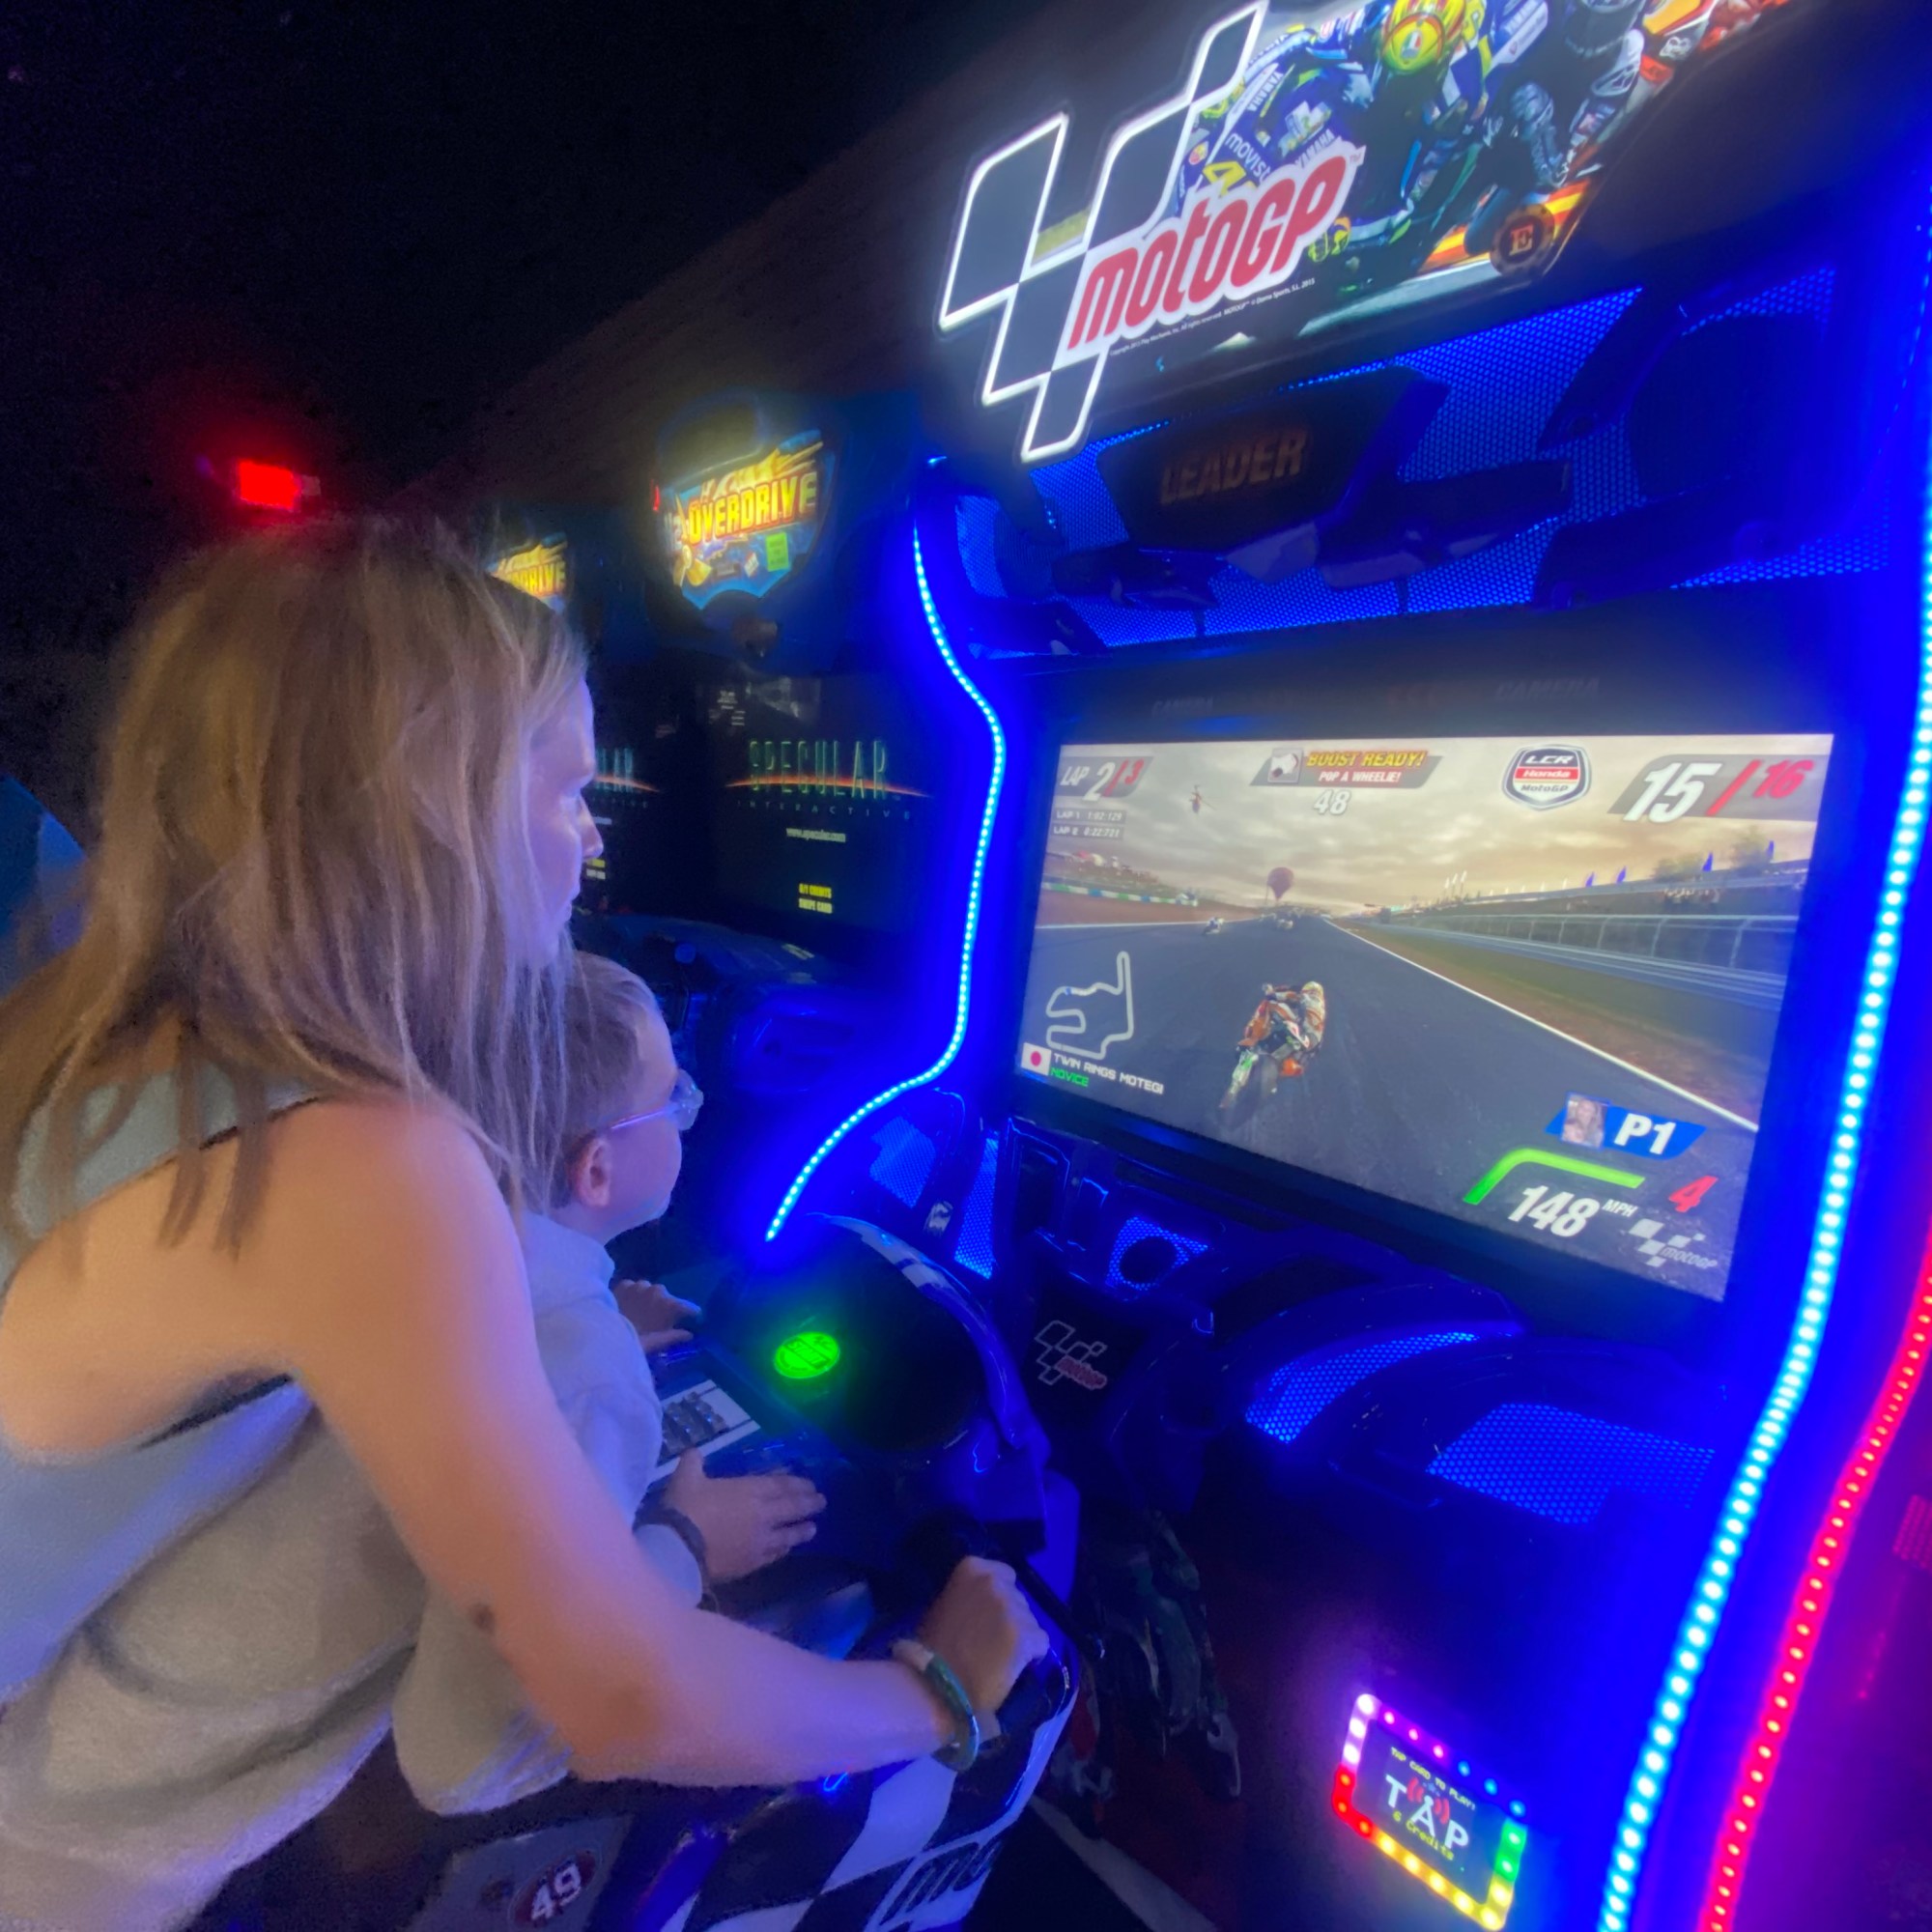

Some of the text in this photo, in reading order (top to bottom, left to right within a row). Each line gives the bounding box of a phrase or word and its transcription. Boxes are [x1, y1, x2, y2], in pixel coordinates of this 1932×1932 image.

[1160, 428, 1310, 505] LEADER
[688, 470, 817, 547] OVERDRIVE
[750, 741, 887, 800] SPECULAR
[1060, 766, 1091, 786] LAP
[1306, 750, 1429, 768] BOOST READY!
[1319, 771, 1403, 783] POP A WHEELIE!
[1522, 769, 1572, 779] Honda
[1524, 754, 1574, 766] LCR
[1313, 788, 1351, 816] 48
[1520, 782, 1570, 793] MotoGP
[1050, 1066, 1090, 1088] NOVICE
[1053, 1052, 1165, 1094] TWIN RINGS MOTEGI
[1613, 1113, 1677, 1155] P1
[1508, 1184, 1639, 1237] 148 MPH
[1668, 1175, 1719, 1213] 4
[1385, 1774, 1470, 1850] TAP
[1406, 1818, 1455, 1861] Credits
[531, 1863, 582, 1920] 49
